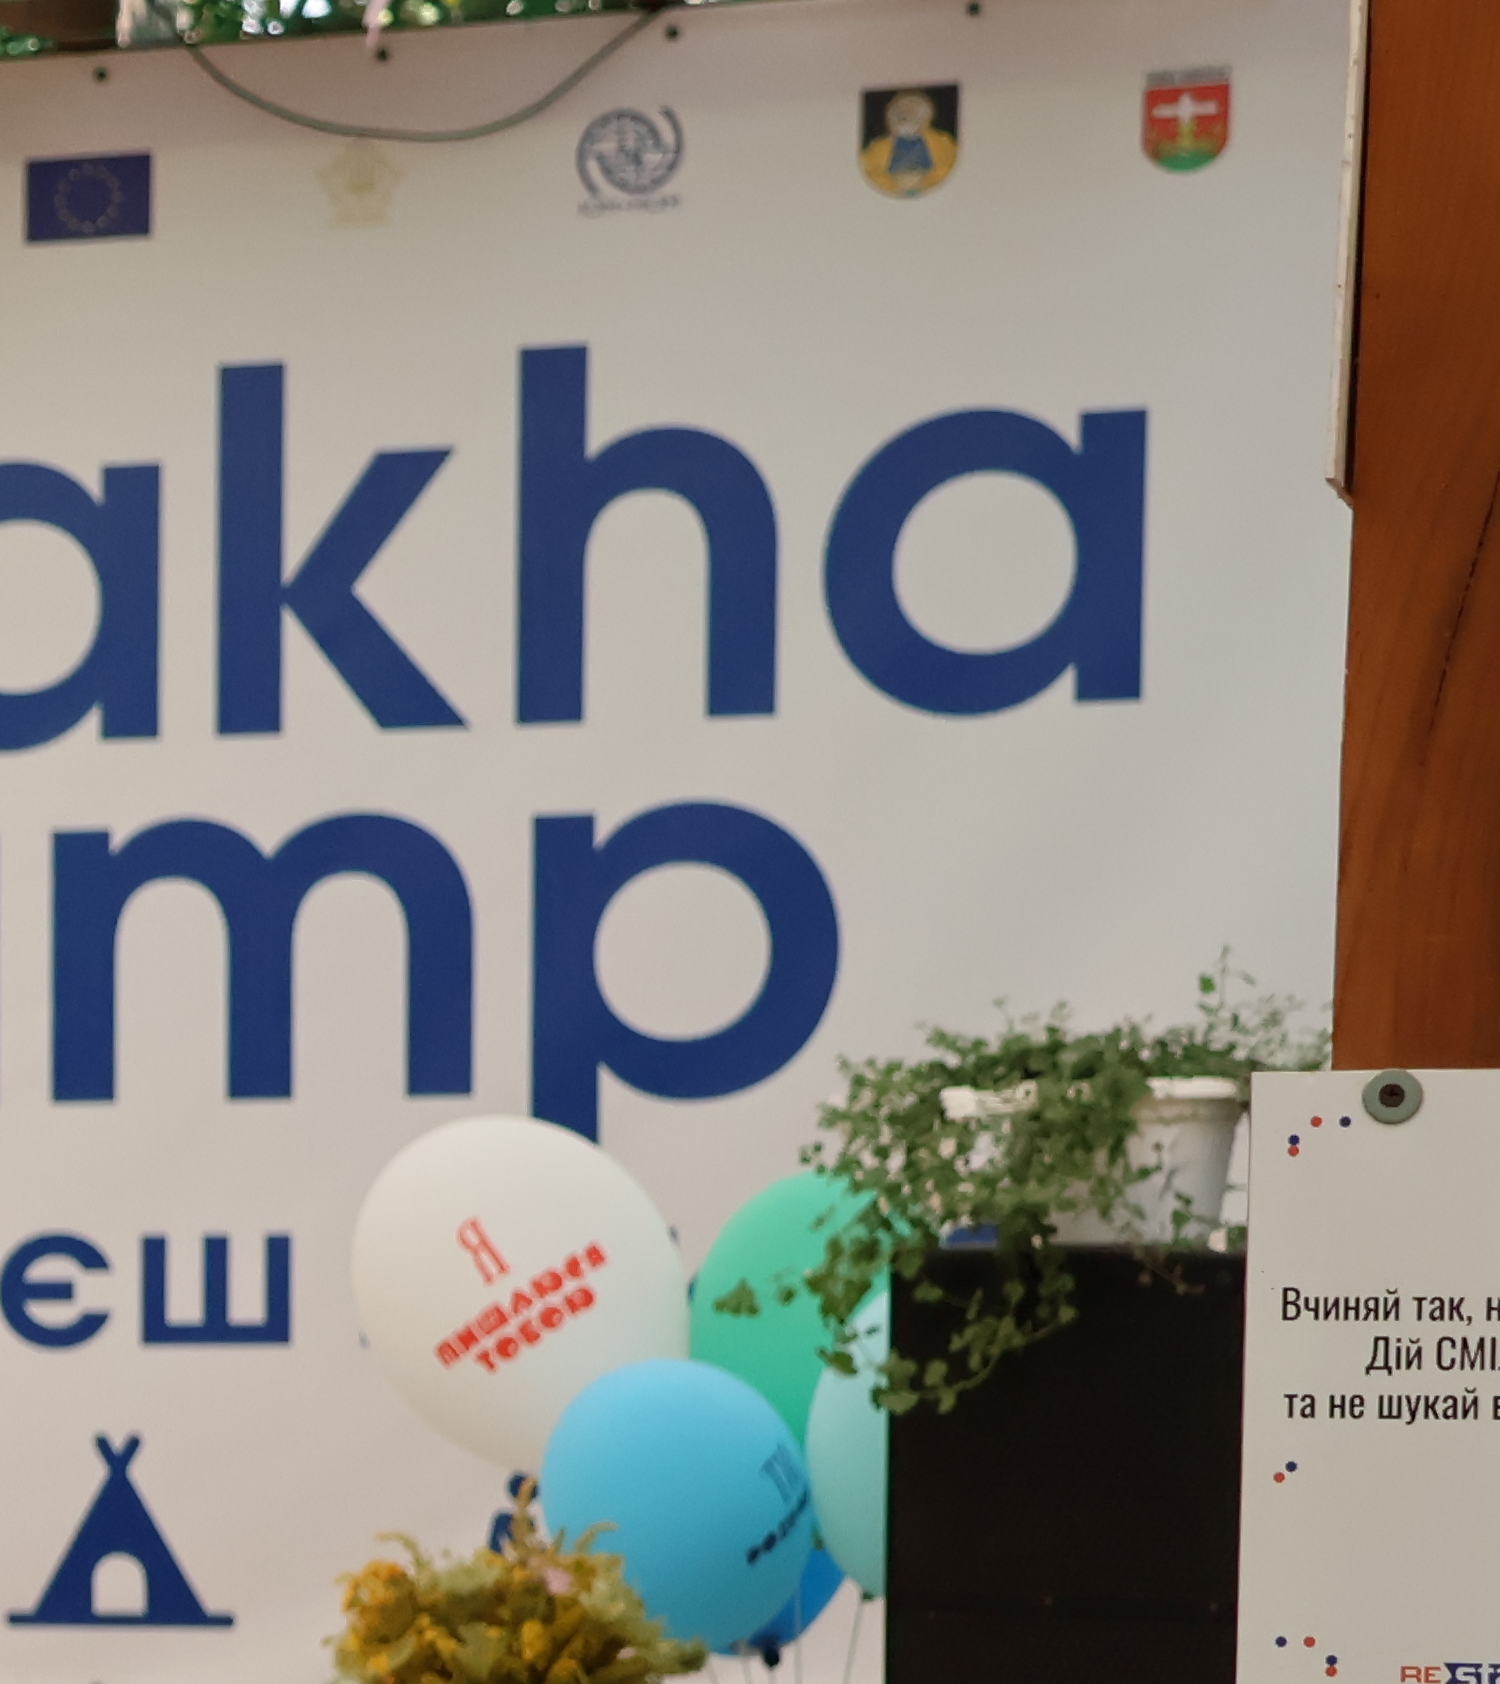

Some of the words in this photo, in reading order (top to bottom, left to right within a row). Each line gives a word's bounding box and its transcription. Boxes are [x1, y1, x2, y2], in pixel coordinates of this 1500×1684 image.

[1281, 1286, 1401, 1322] Вчиняй
[1412, 1296, 1473, 1327] так,
[1365, 1335, 1422, 1376] Дій
[1436, 1336, 1500, 1371] СМІ
[1283, 1393, 1316, 1419] та
[1328, 1394, 1365, 1420] не
[1377, 1387, 1479, 1426] шукай
